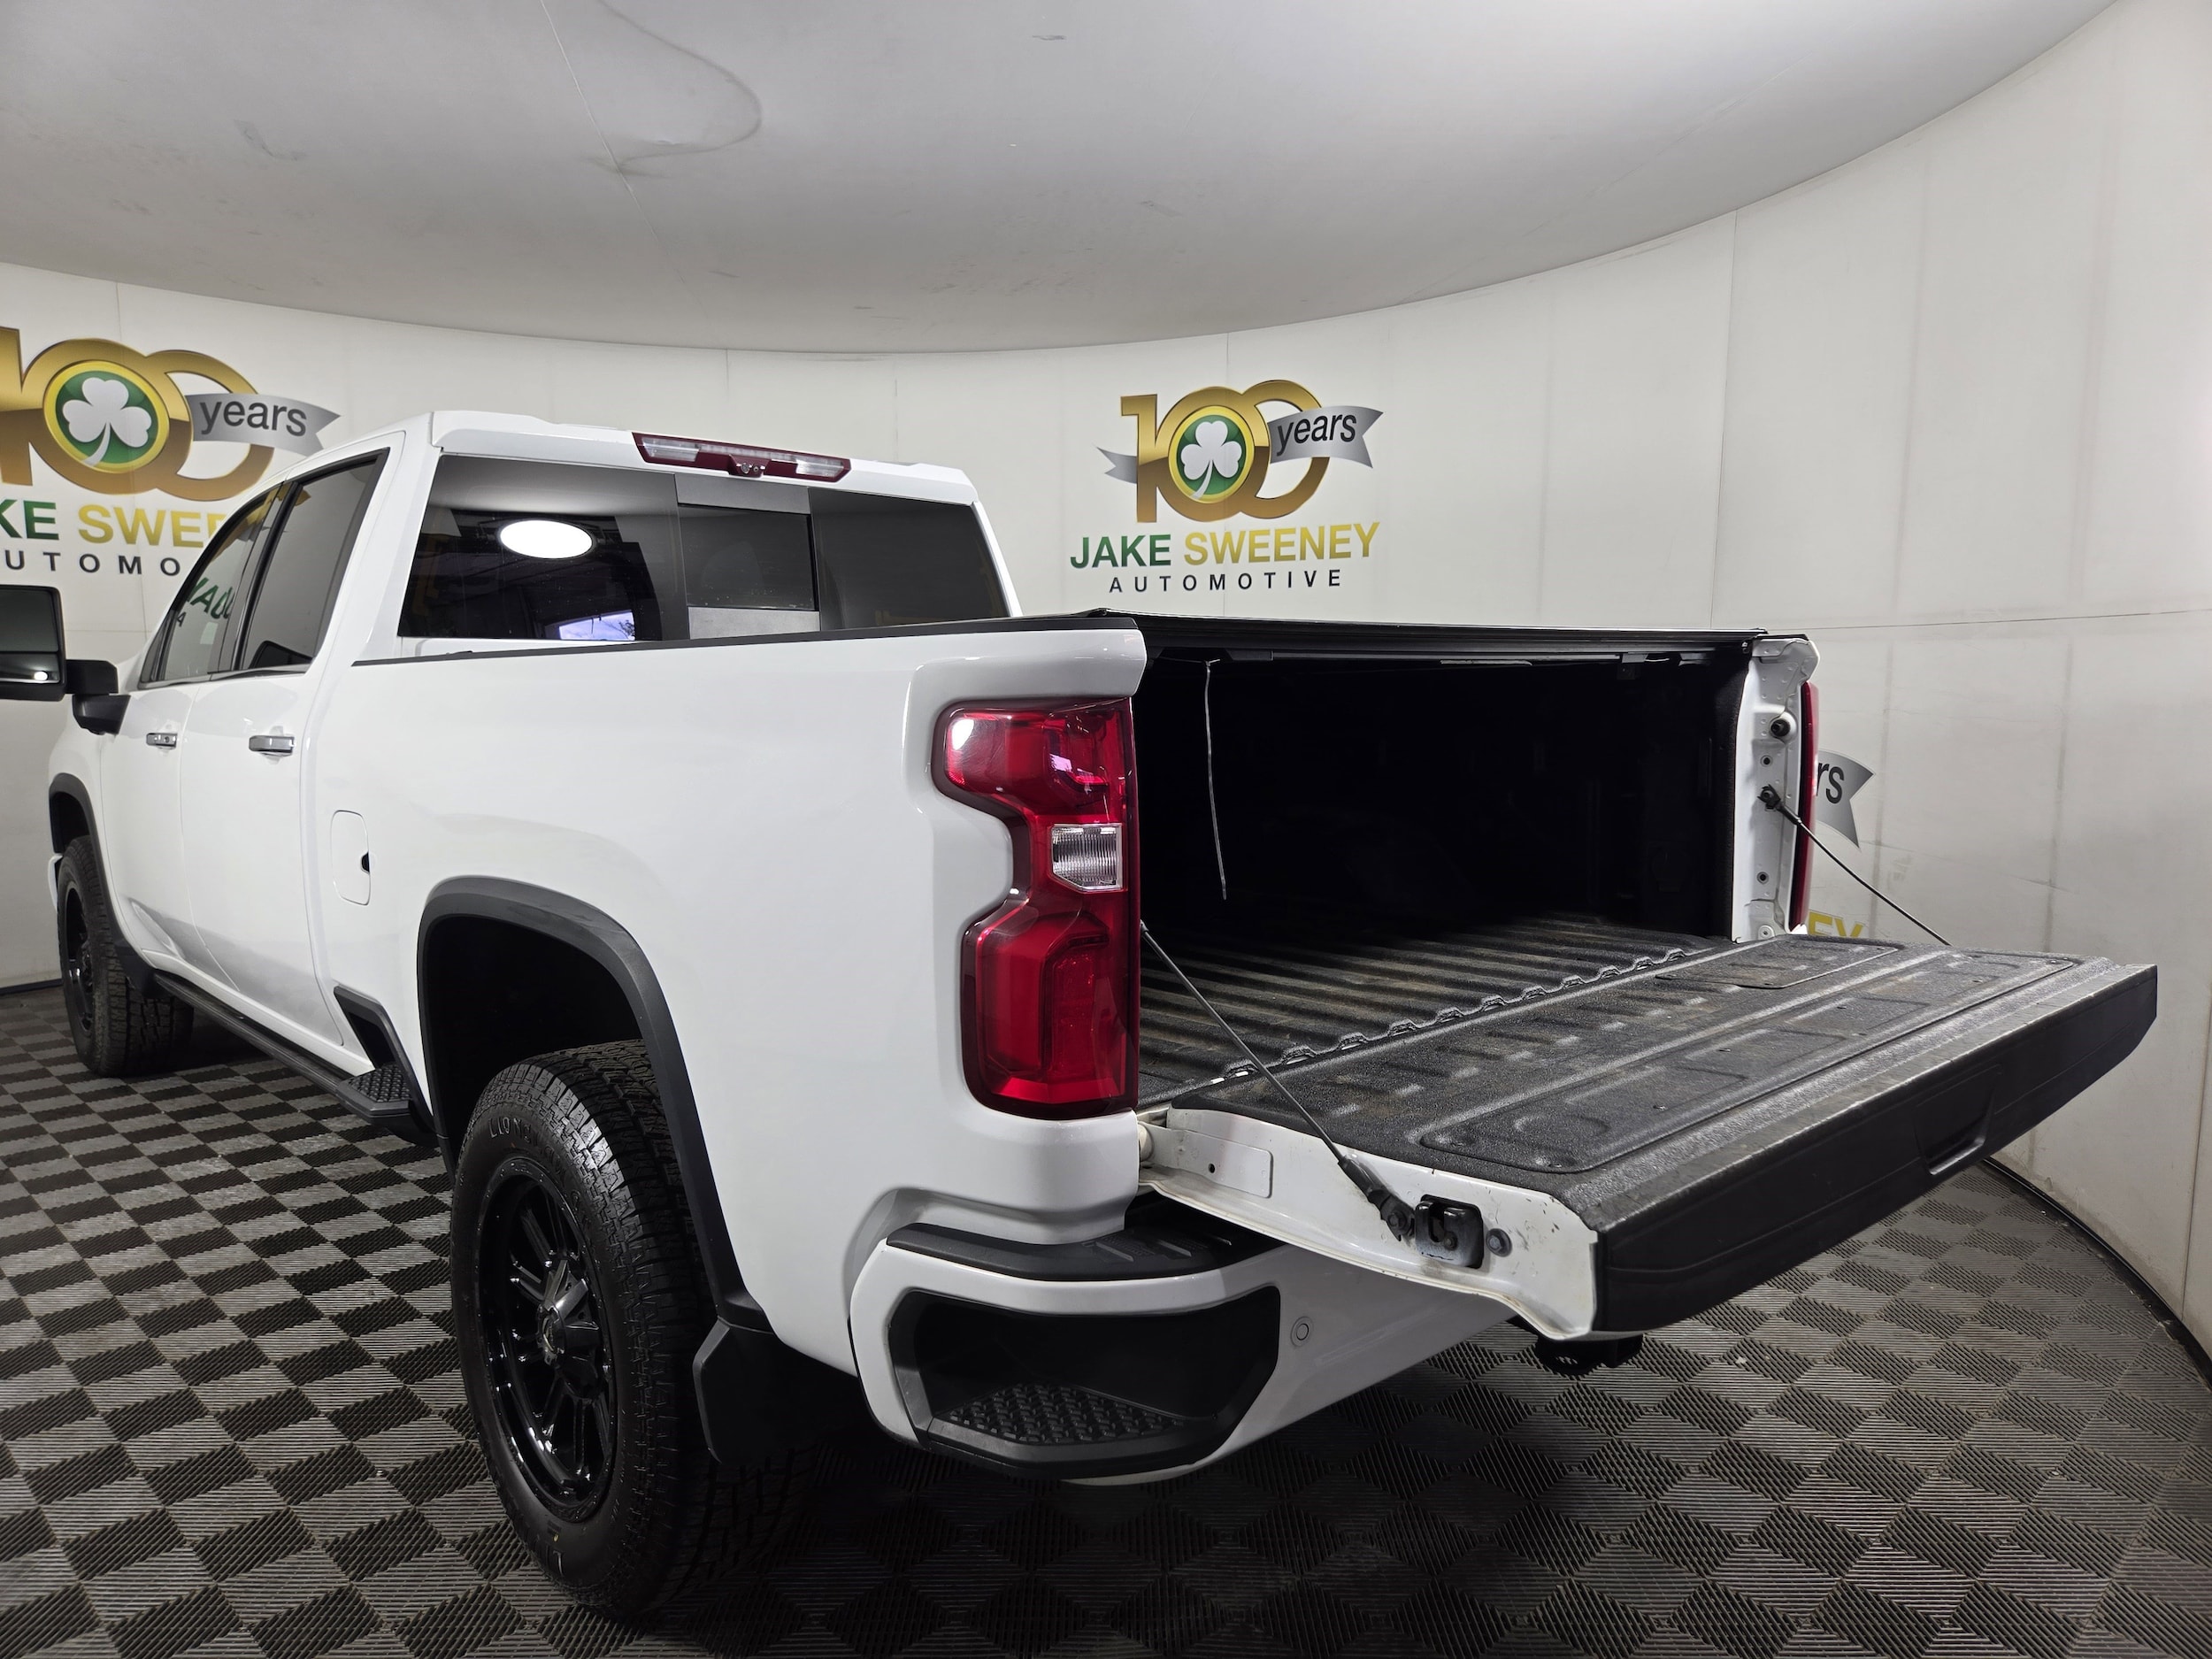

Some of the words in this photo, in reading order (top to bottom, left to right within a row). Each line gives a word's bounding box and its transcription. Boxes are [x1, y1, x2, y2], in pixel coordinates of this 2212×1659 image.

[199, 400, 307, 436] years
[1277, 414, 1357, 457] years
[1120, 380, 1331, 523] 100
[0, 499, 59, 541] KE
[4, 549, 180, 576] UTOMO
[1070, 534, 1171, 569] JAKE
[1184, 522, 1380, 565] SWEENEY
[1109, 569, 1340, 594] AUTOMOTIVE
